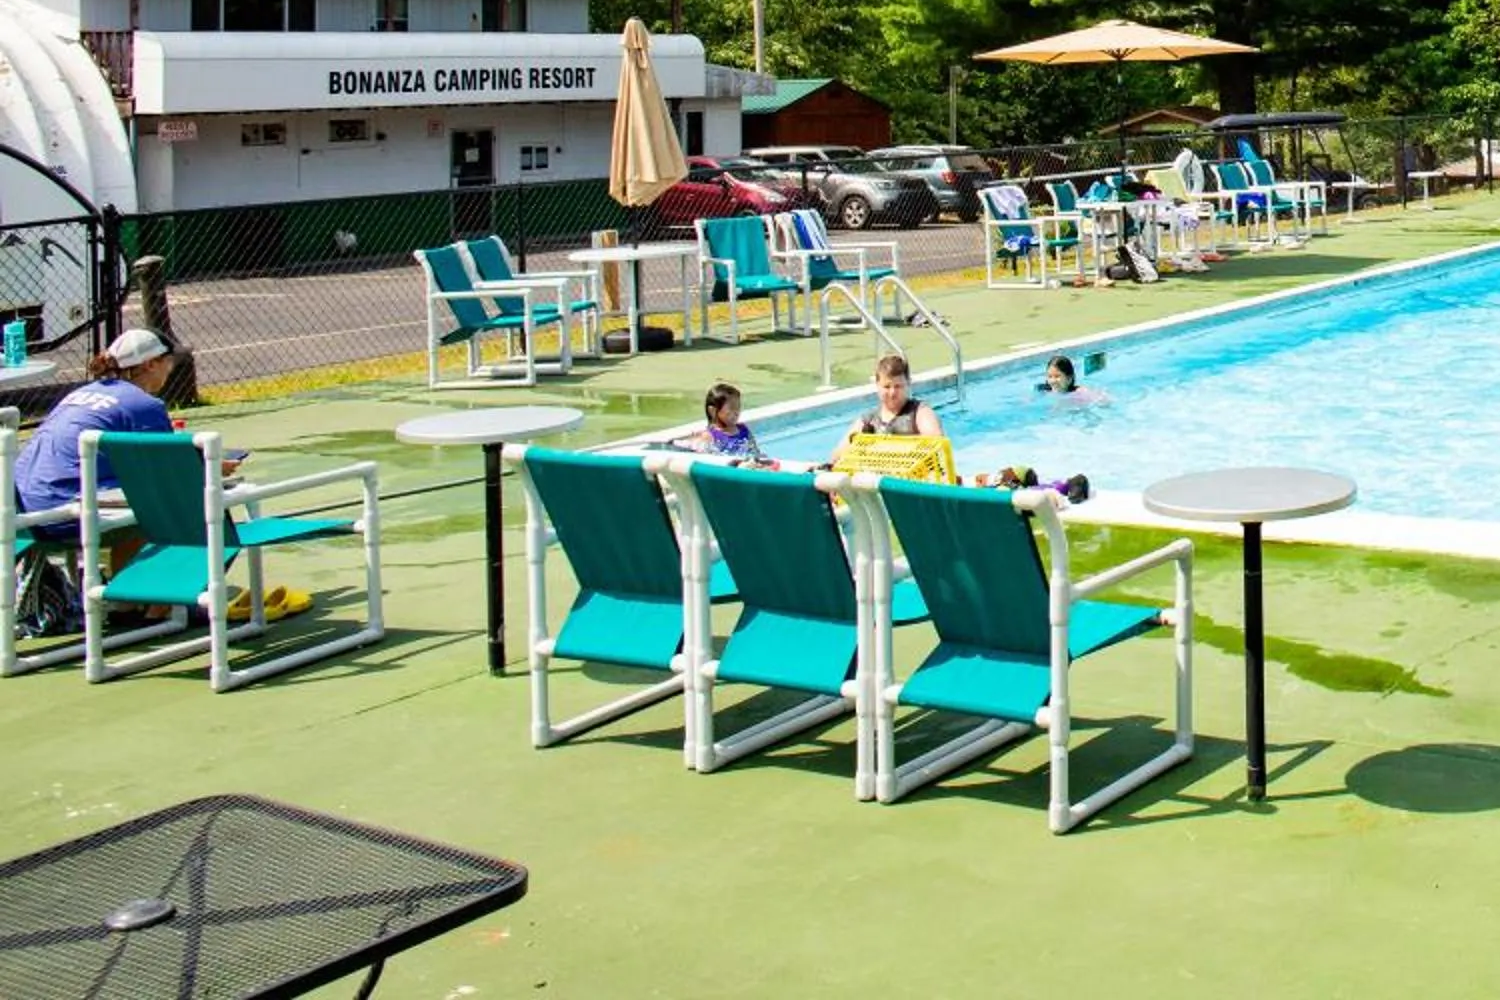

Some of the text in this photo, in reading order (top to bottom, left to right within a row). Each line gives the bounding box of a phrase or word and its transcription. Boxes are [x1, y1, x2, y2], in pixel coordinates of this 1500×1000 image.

[328, 67, 597, 95] BONANZA CAMPING RESORT
